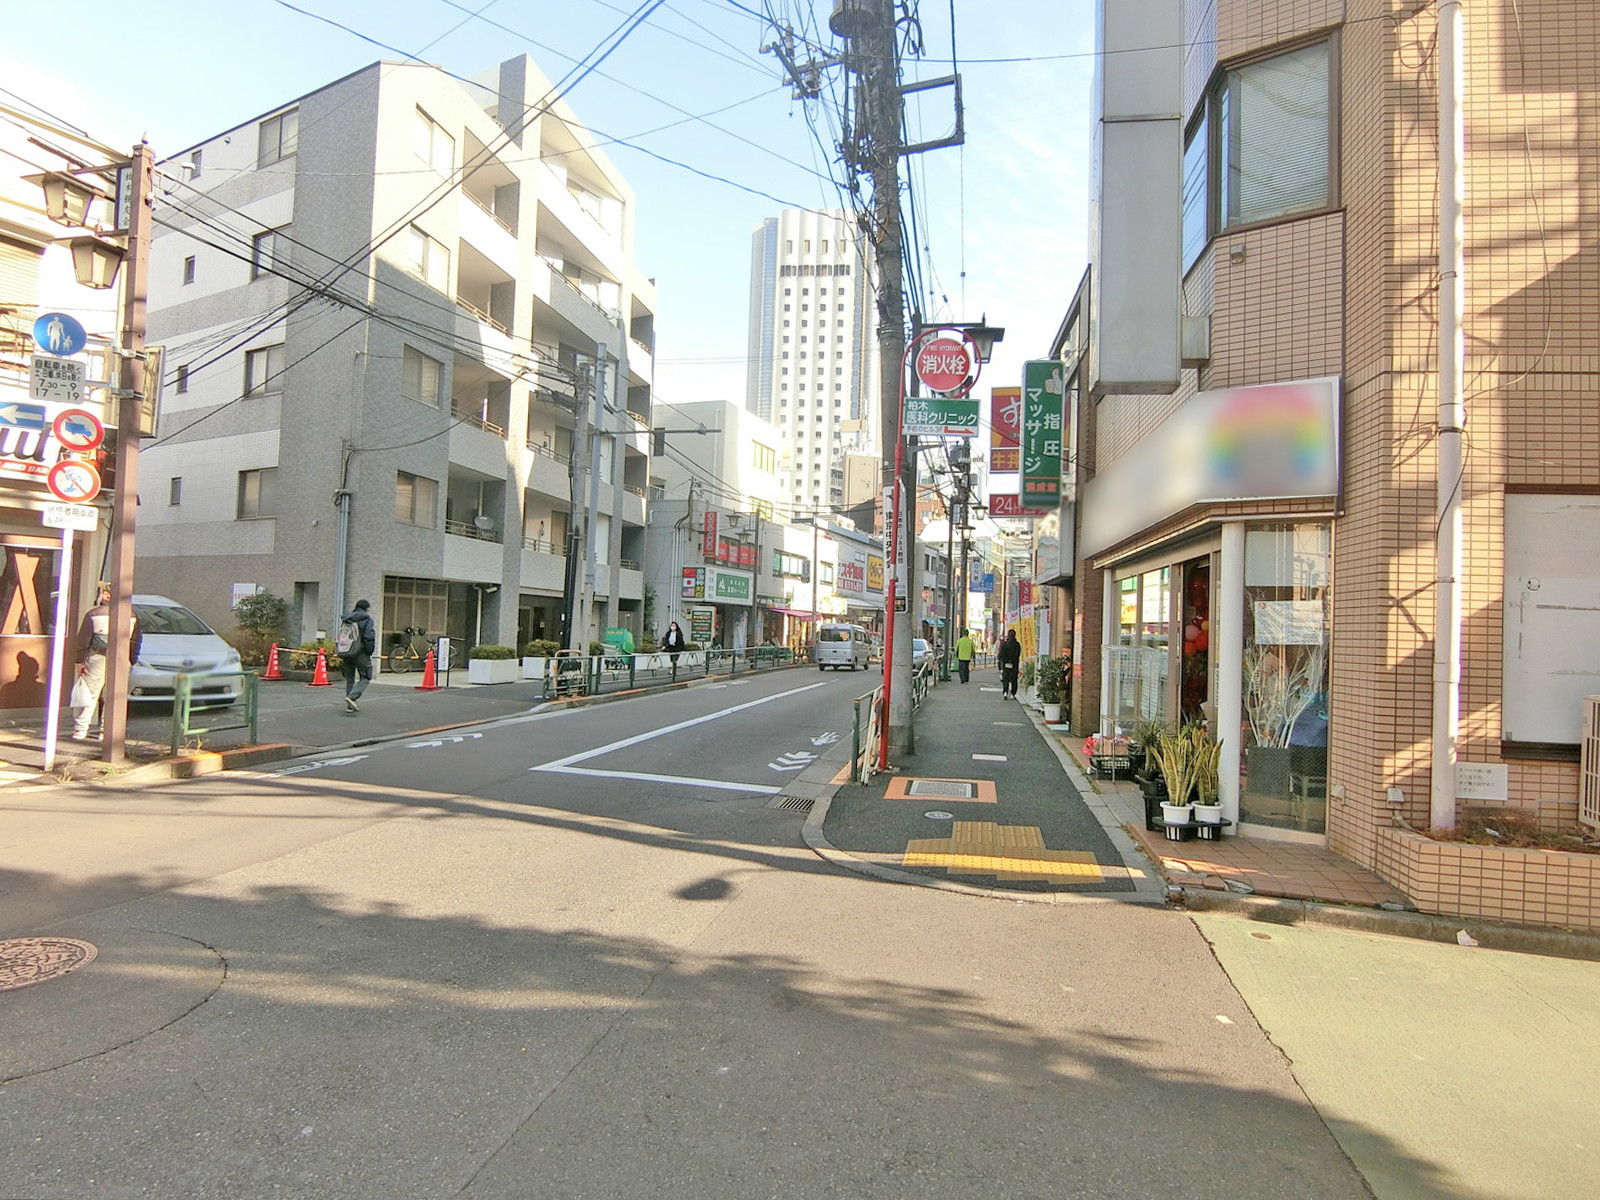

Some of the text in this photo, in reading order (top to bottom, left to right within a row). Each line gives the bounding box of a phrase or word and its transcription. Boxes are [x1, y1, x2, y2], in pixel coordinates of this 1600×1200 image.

[922, 354, 966, 375] 消火栓
[908, 400, 929, 411] 柏木
[906, 411, 977, 425] 医科クリニック
[1024, 387, 1044, 474] マッサージ
[1042, 412, 1061, 457] 指圧
